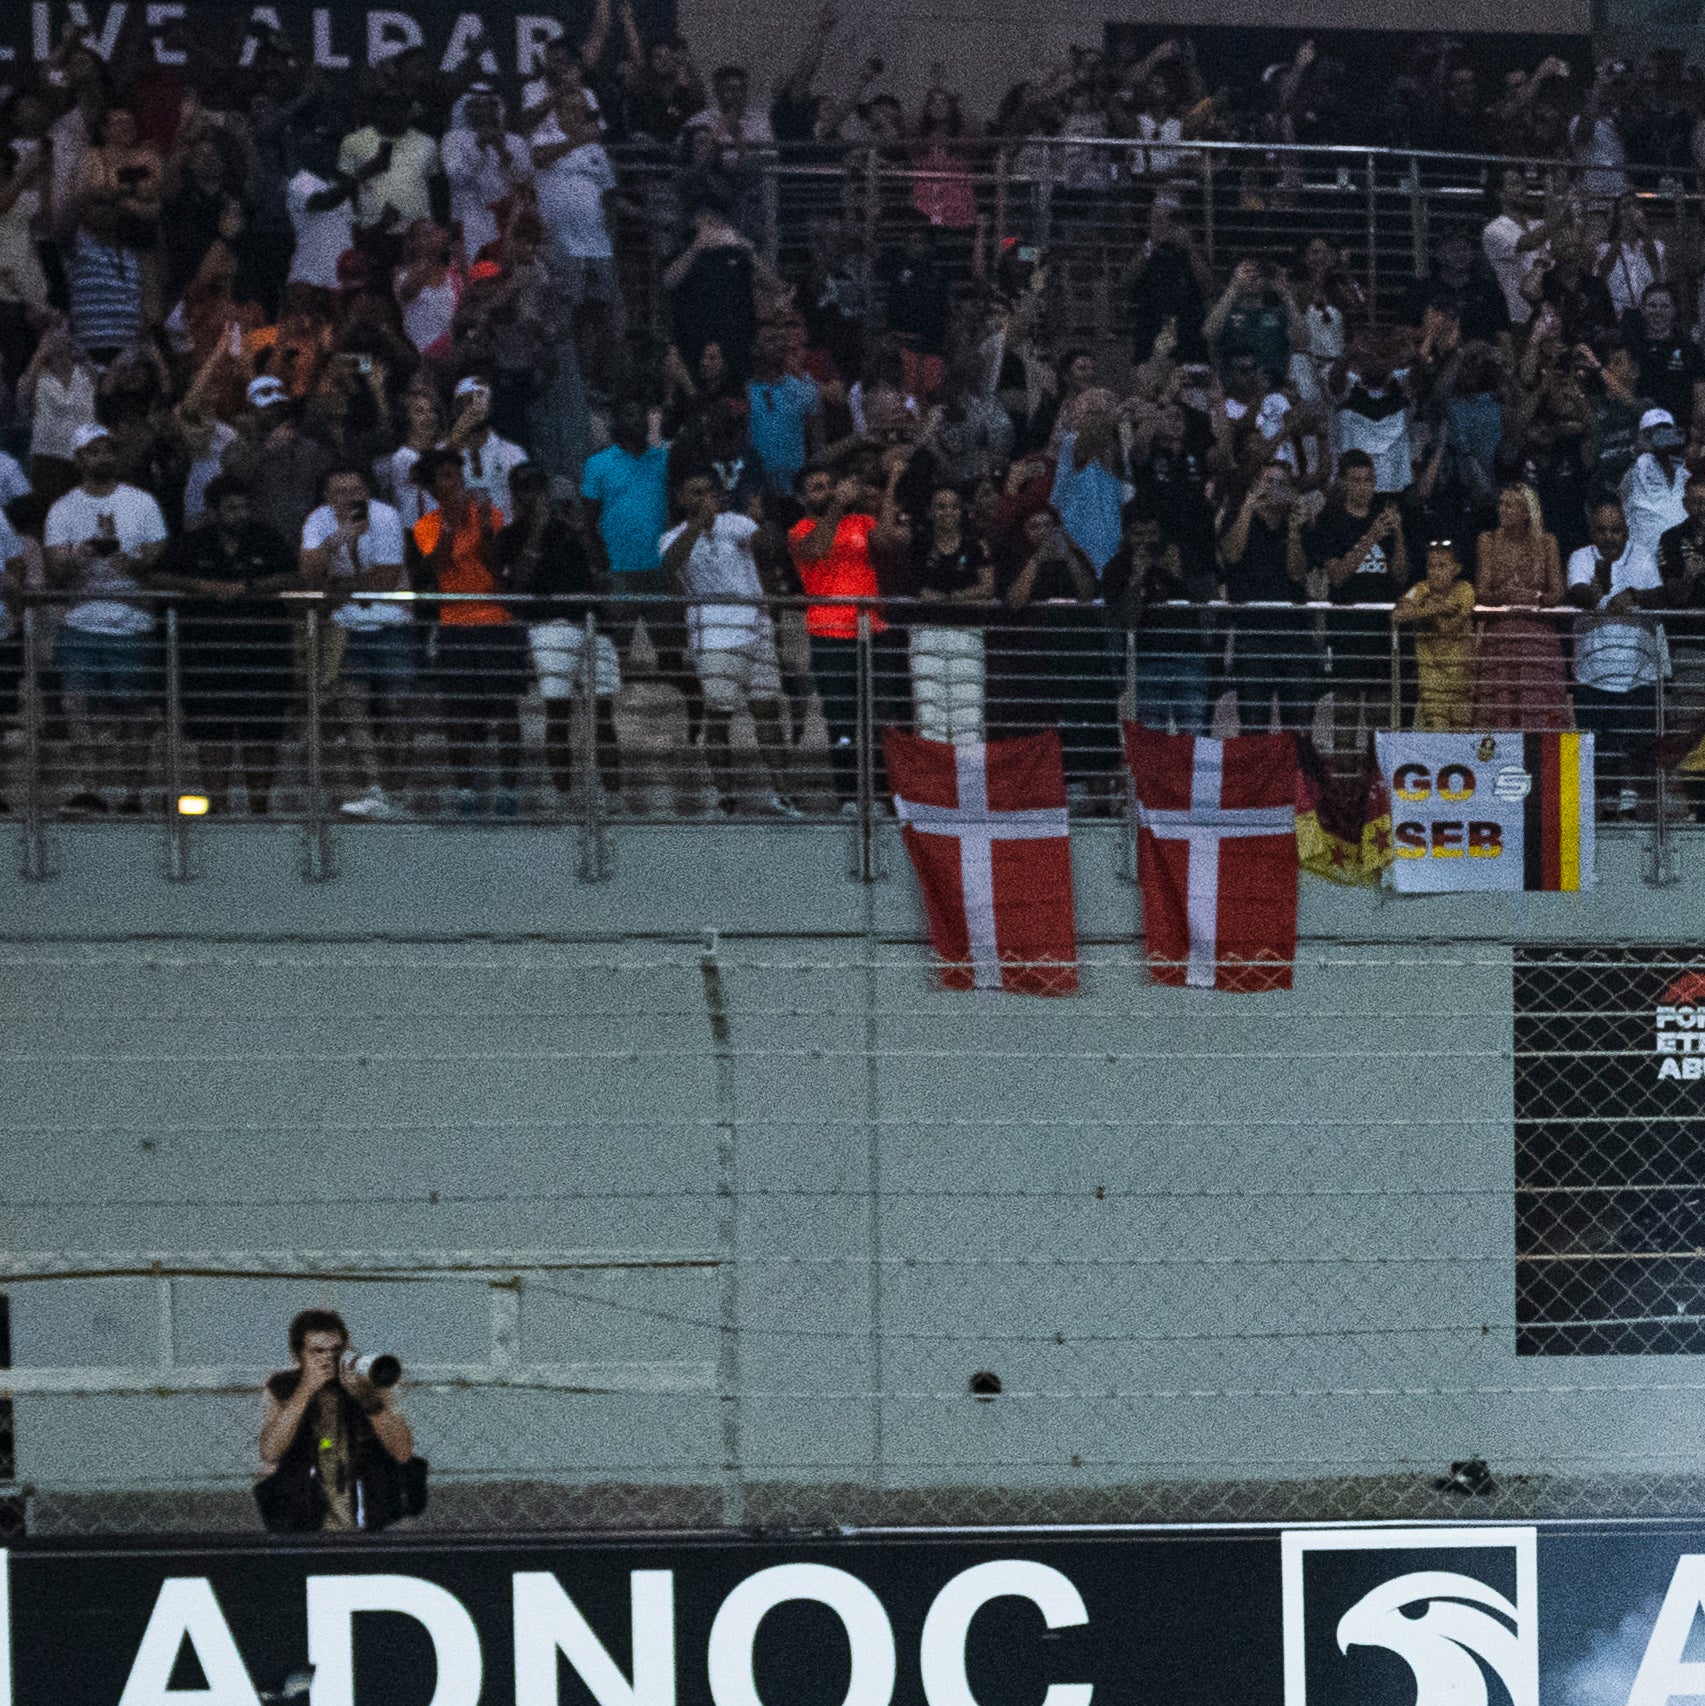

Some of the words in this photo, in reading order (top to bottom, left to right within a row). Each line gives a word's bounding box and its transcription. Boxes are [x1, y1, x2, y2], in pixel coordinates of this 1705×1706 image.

[0, 3, 188, 64] IVE
[1393, 762, 1477, 802] GO
[1395, 820, 1503, 859] SEB
